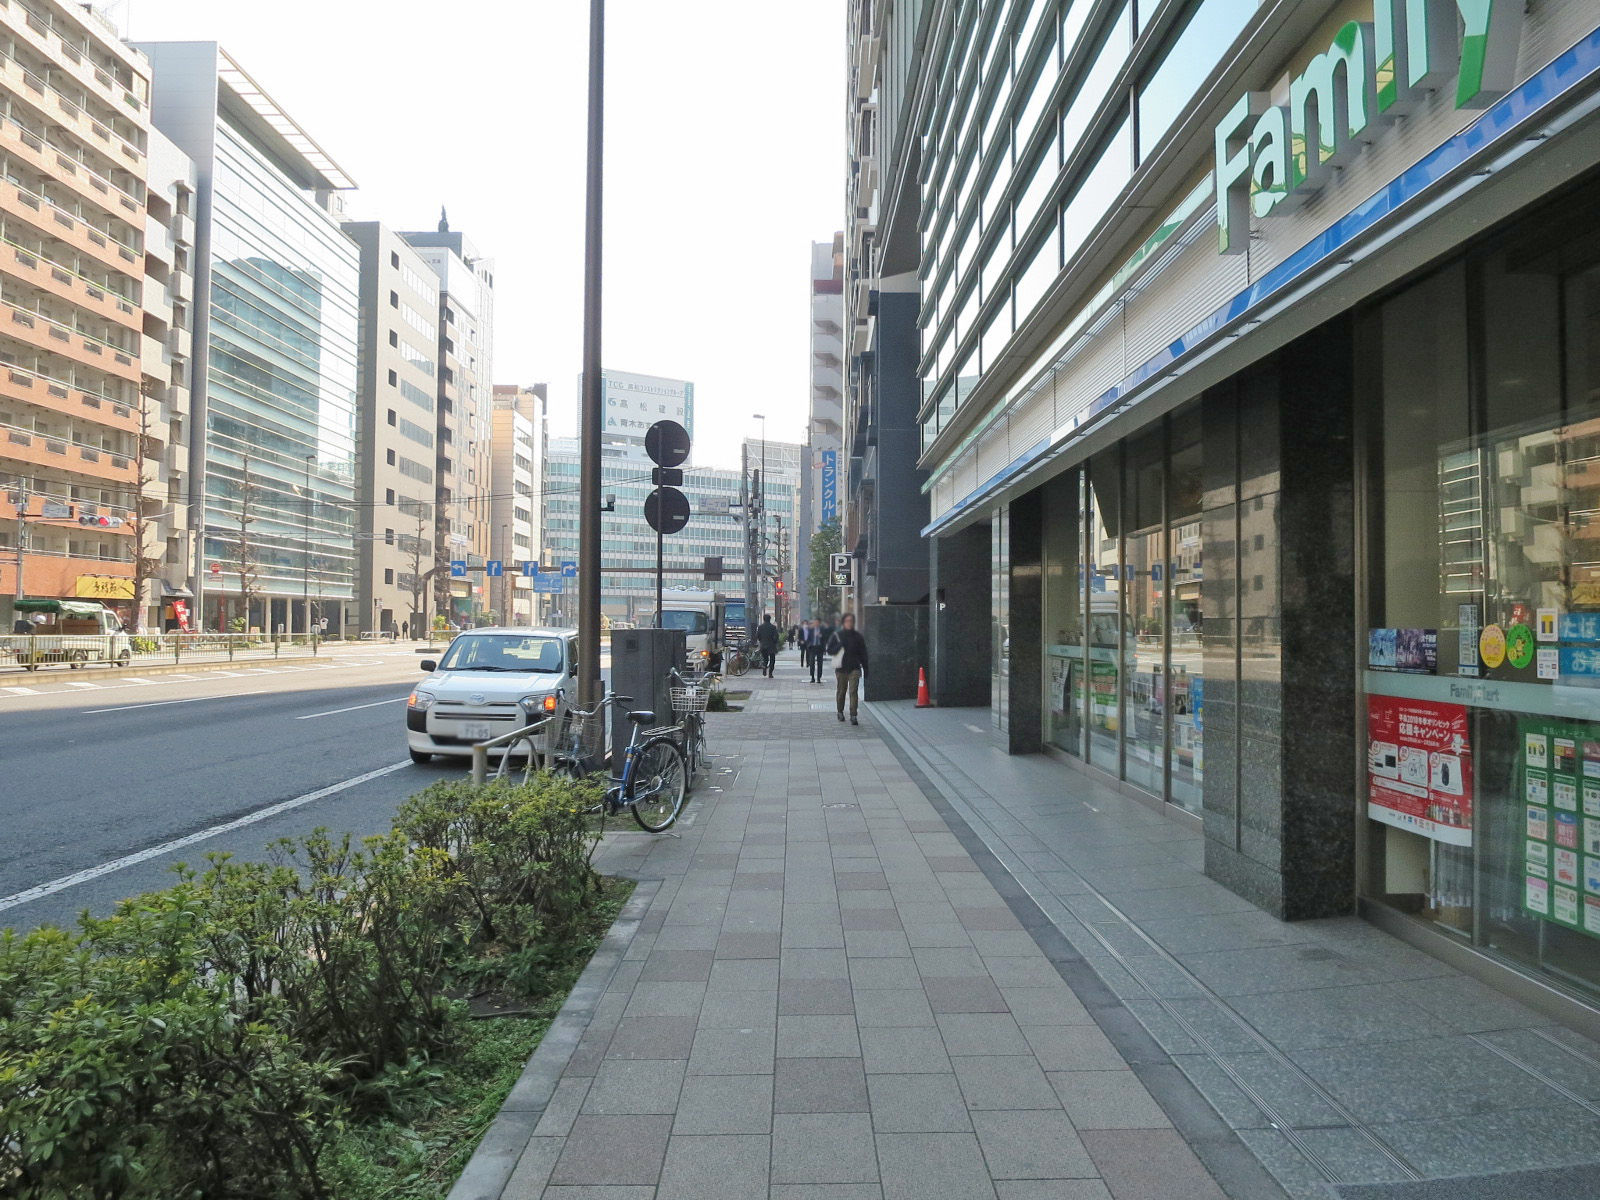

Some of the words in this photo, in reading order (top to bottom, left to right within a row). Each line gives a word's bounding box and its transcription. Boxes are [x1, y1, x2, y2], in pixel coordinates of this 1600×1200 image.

[608, 380, 624, 389] TCG
[823, 454, 835, 526] トランクルー
[835, 556, 847, 571] P
[835, 573, 847, 585] 空
